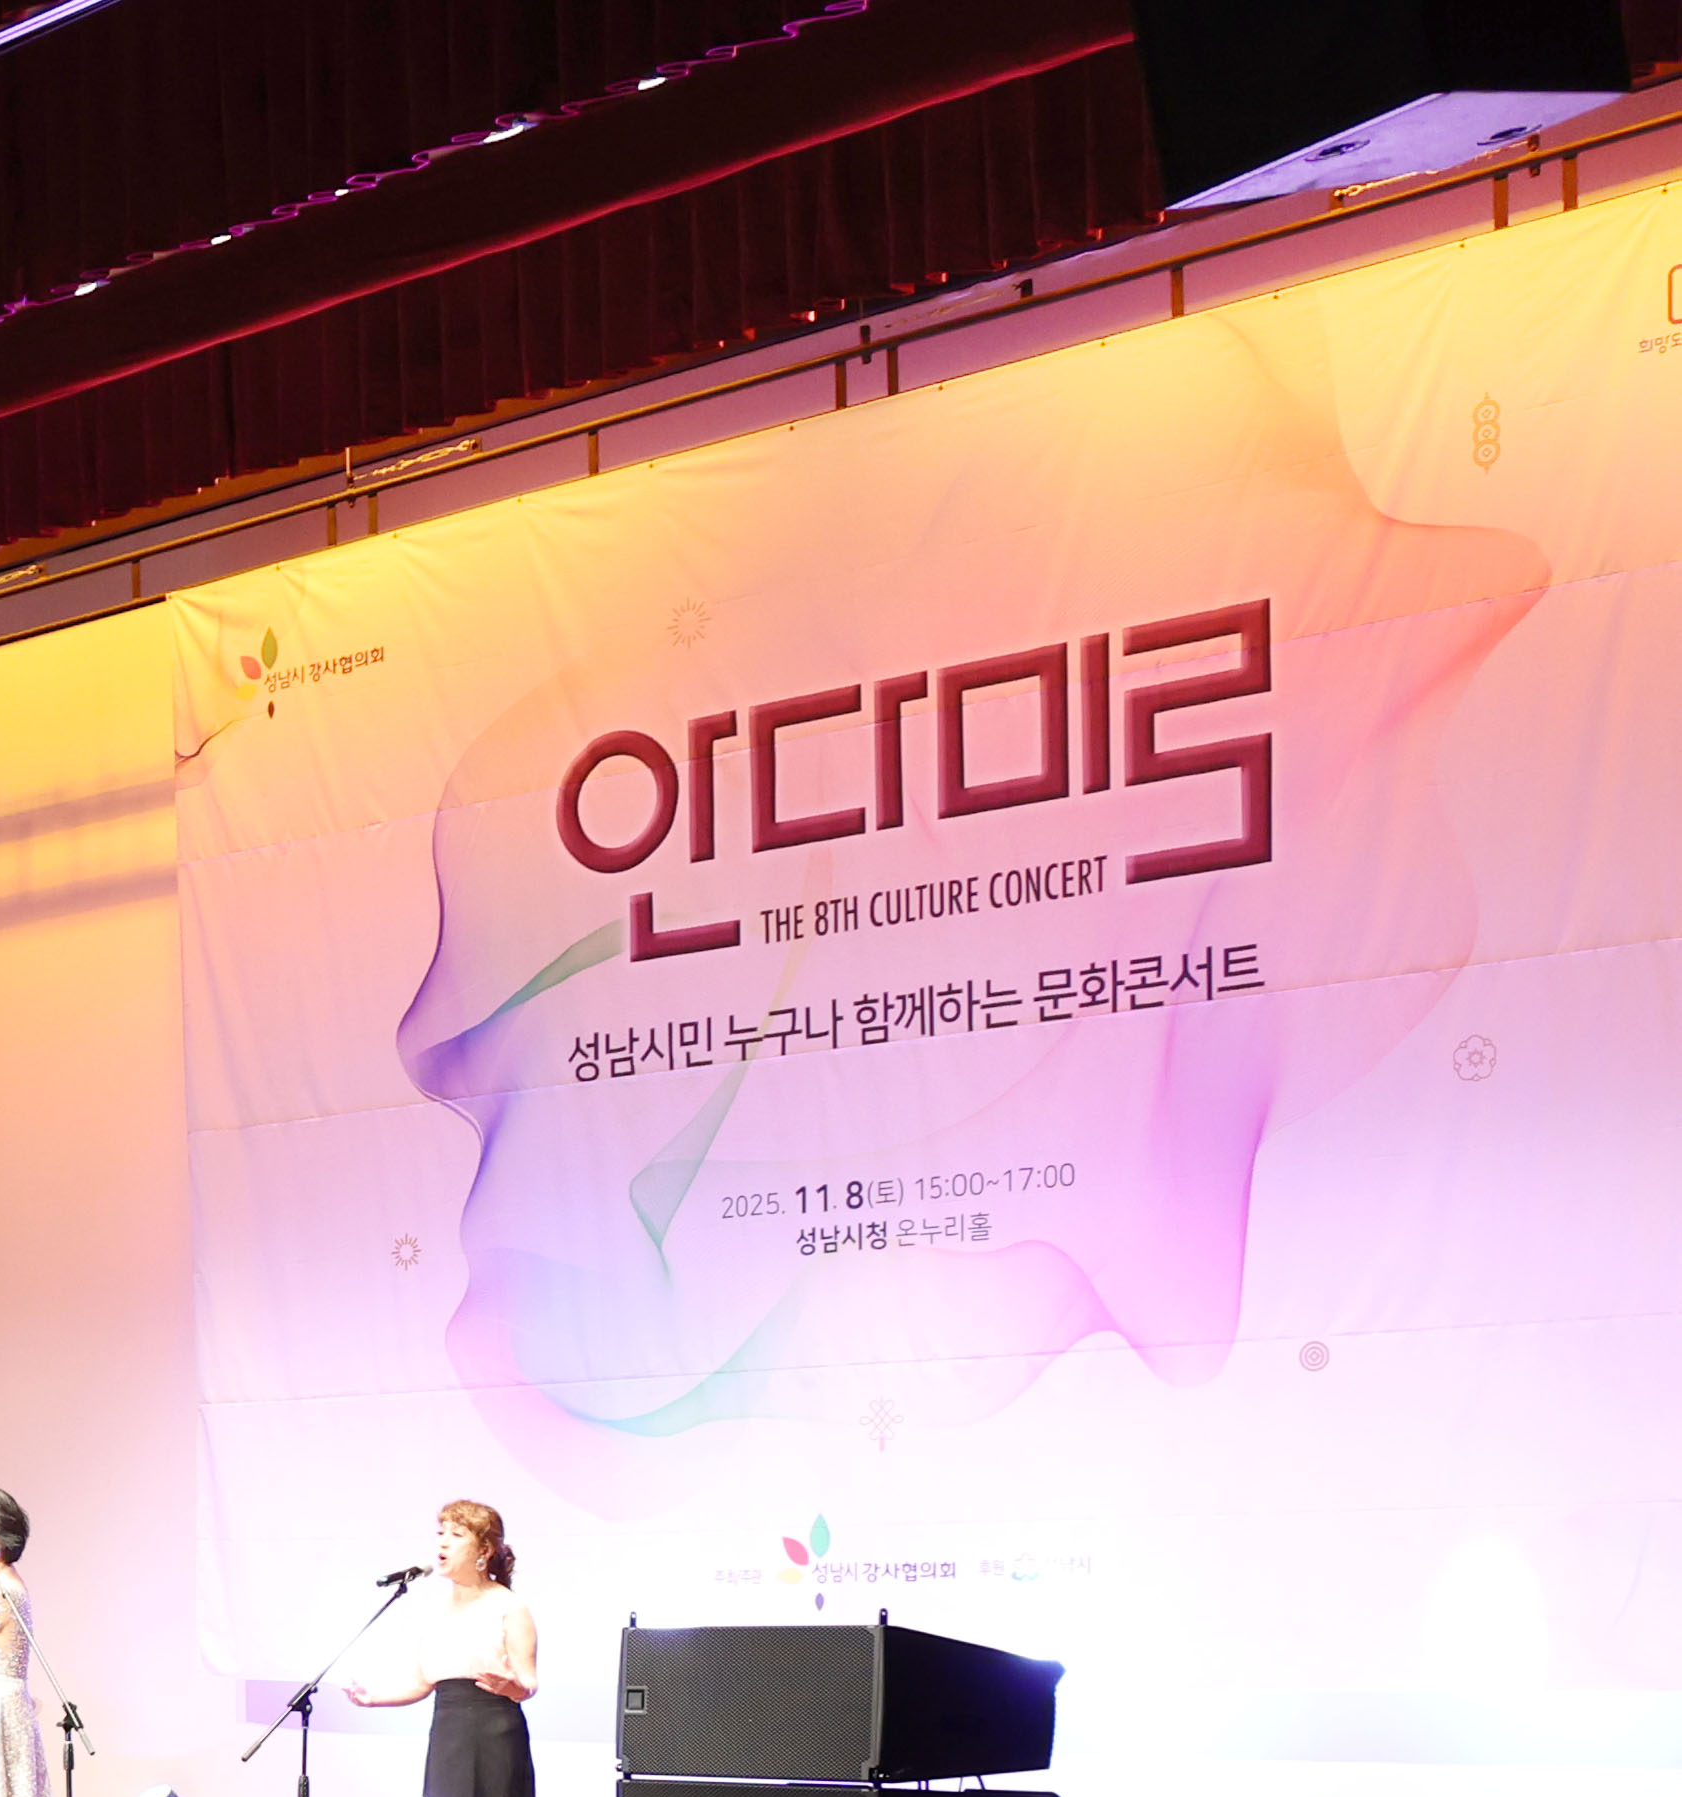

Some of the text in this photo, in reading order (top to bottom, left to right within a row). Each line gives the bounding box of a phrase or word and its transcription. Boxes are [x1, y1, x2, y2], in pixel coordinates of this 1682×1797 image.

[264, 646, 385, 693] 성남시 강사협의회
[760, 855, 1108, 944] THE 8TH CULTURE CONCERT
[567, 943, 1266, 1083] 성남시민 누구나 함께하는 문화콘서트
[721, 1192, 786, 1219] 2025.
[795, 1183, 837, 1214] 11.
[915, 1163, 1076, 1201] 15:00~17:00
[796, 1212, 993, 1256] 성남시청 온누리홀
[811, 1561, 957, 1584] 성남시 강사협의회
[1045, 1555, 1093, 1575] 남시
